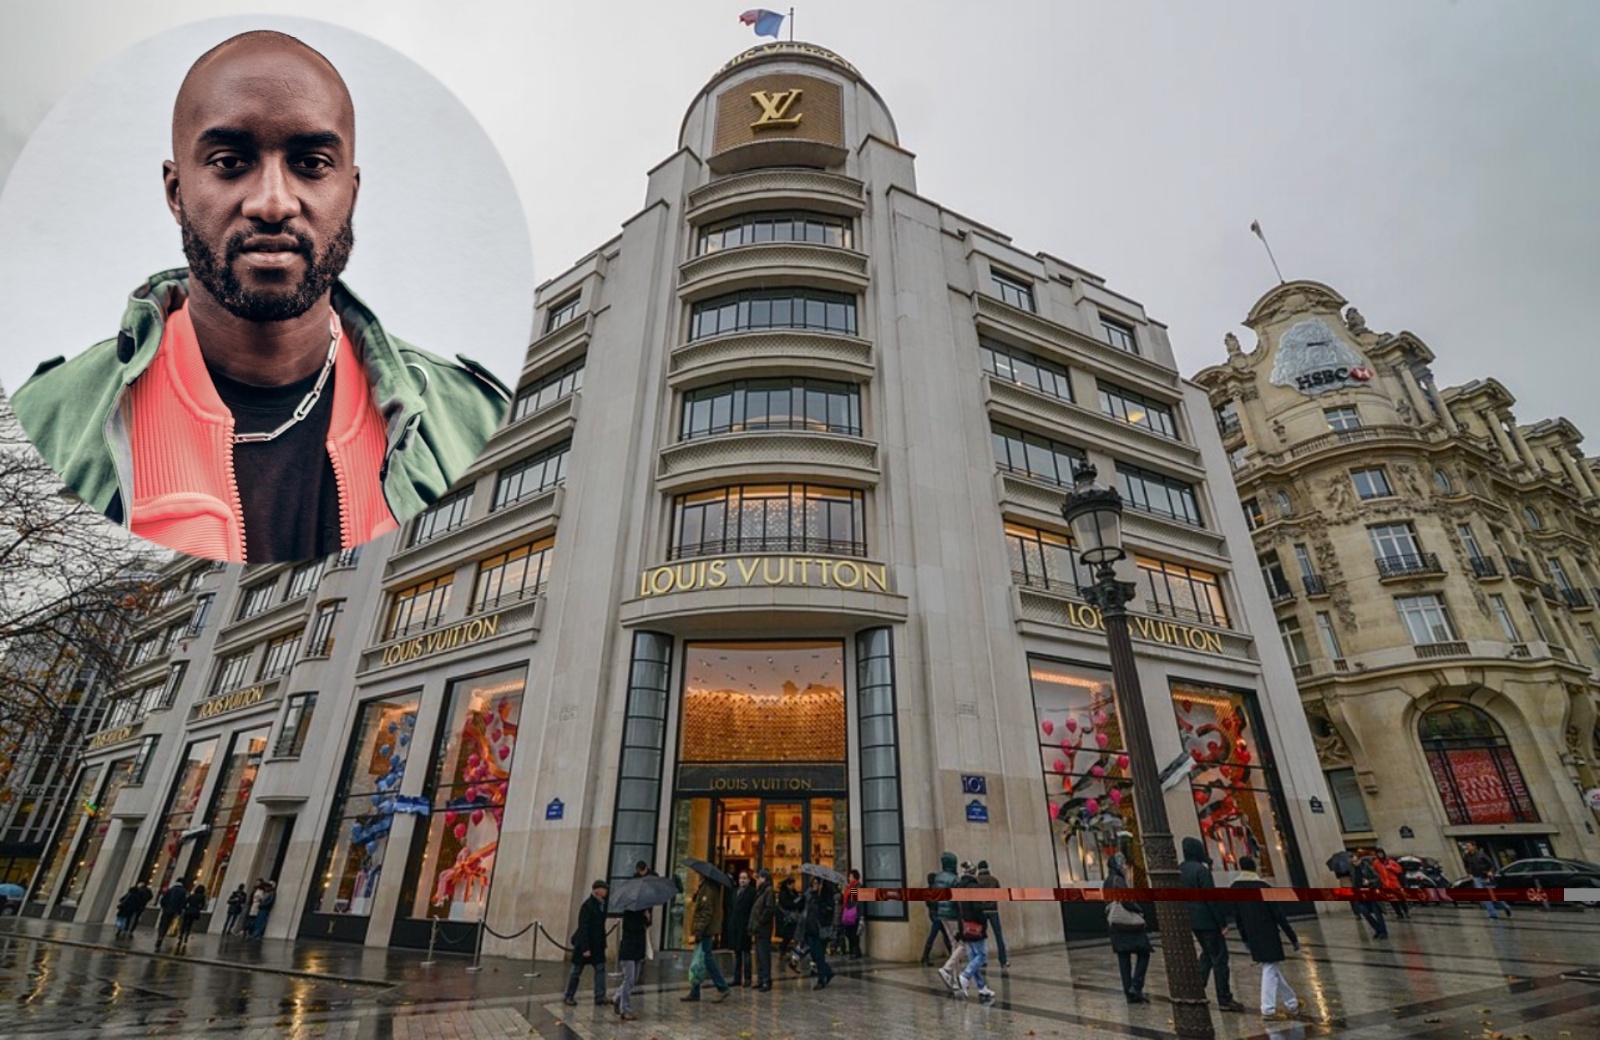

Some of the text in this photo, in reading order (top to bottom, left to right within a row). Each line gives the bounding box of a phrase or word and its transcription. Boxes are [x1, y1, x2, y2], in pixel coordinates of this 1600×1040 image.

[1295, 367, 1349, 390] HSBC
[640, 557, 888, 597] LOUIS VUITTON
[382, 615, 499, 667] LOUIS VUITTON
[1135, 617, 1223, 653] VUITTON
[709, 777, 812, 791] LOUIS VUITTON
